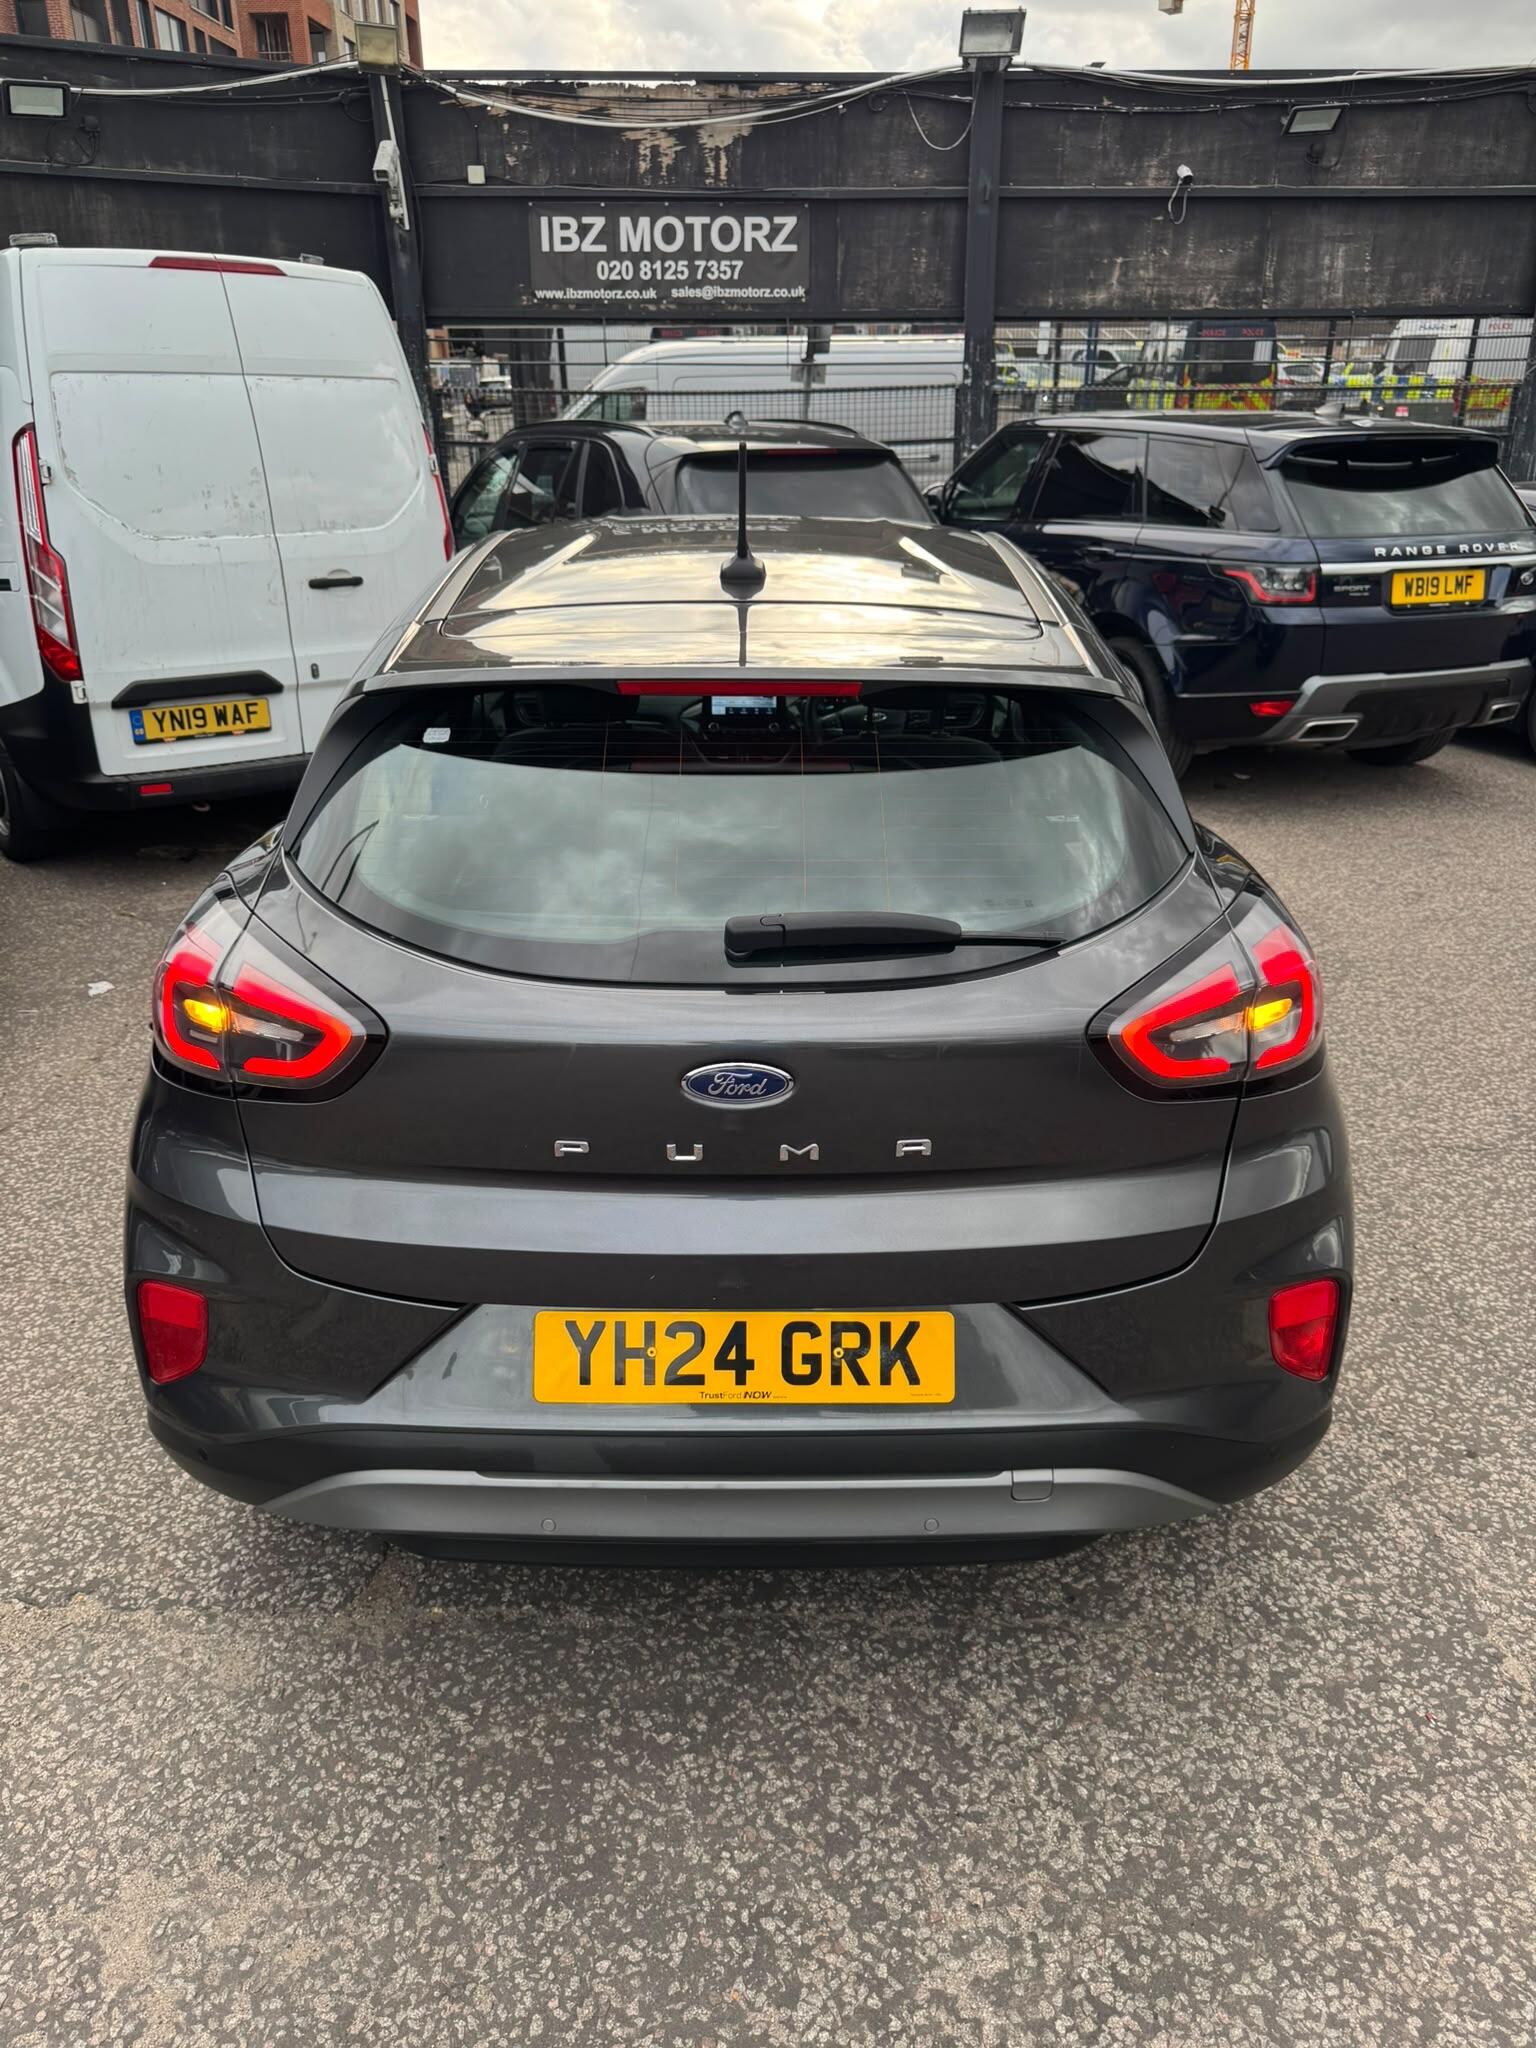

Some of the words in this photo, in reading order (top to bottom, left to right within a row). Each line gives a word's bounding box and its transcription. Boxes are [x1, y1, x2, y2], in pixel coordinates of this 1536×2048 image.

[539, 215, 608, 252] IBZ
[618, 215, 798, 252] MOTORZ
[596, 260, 634, 280] 020
[639, 260, 689, 280] 8125
[694, 260, 744, 280] 7357
[534, 288, 657, 300] www.ibzmotorz.co.uk
[670, 286, 806, 300] sales@ibzmotorz.co.uk
[1373, 545, 1447, 557] RANGE
[1458, 541, 1519, 553] ROVER
[1404, 576, 1440, 597] WB19
[1444, 575, 1475, 595] LMF
[152, 708, 208, 732] YN19
[213, 703, 259, 726] WAF
[708, 1072, 768, 1095] Ford
[554, 1139, 932, 1161] PUMA
[564, 1320, 755, 1386] YH24
[780, 1320, 921, 1386] GRK
[699, 1391, 742, 1399] TrustFord
[743, 1391, 772, 1399] NOW
